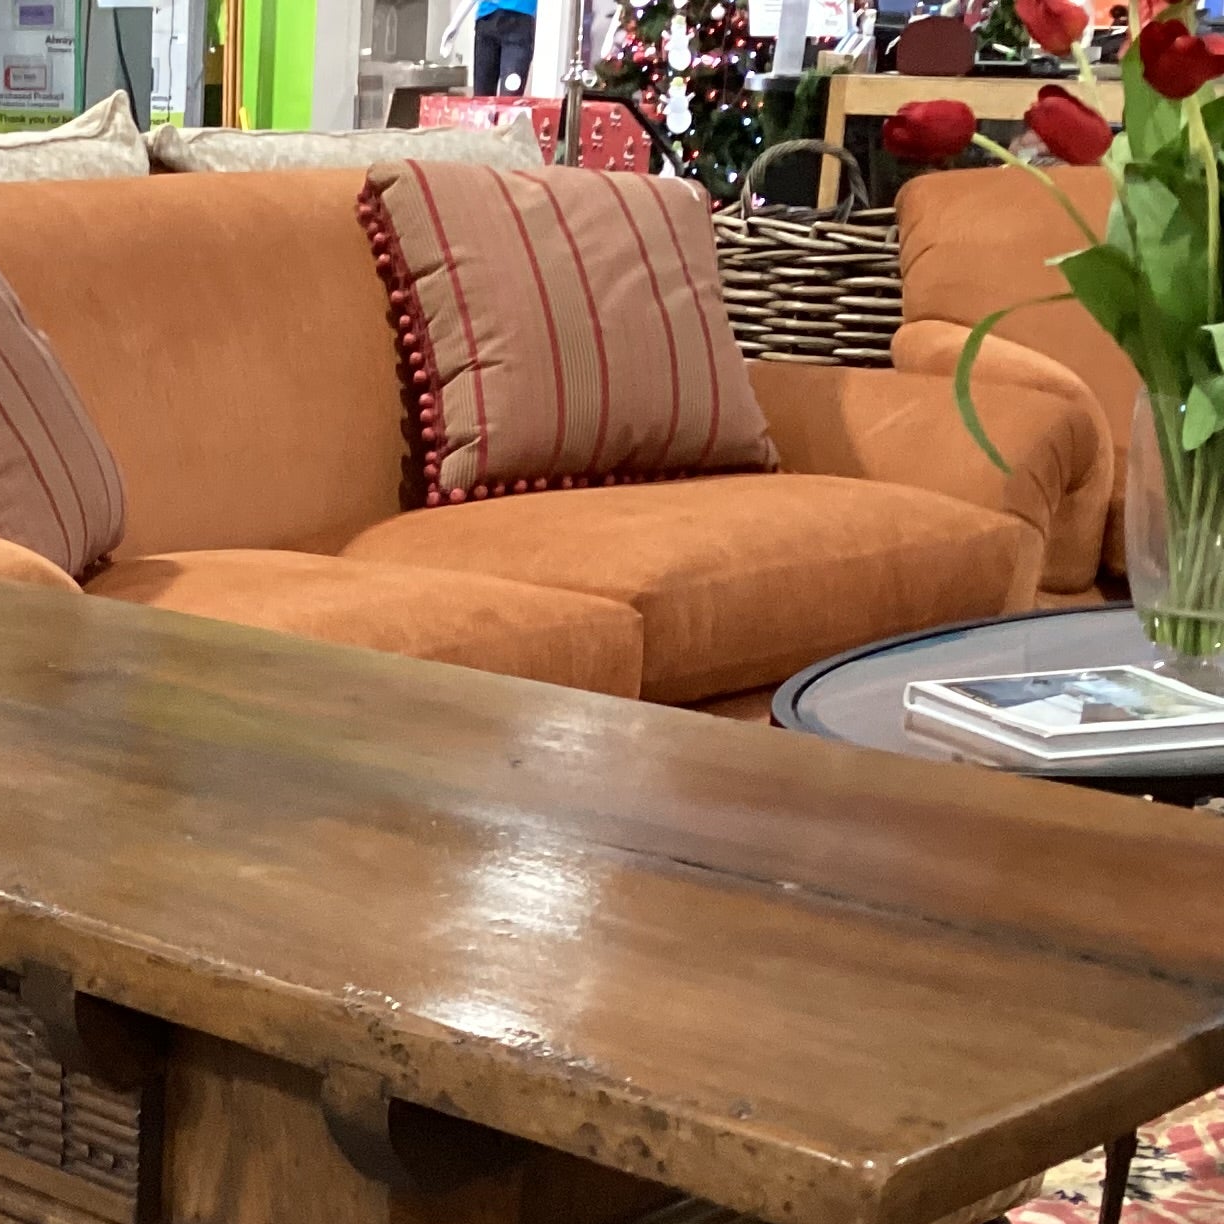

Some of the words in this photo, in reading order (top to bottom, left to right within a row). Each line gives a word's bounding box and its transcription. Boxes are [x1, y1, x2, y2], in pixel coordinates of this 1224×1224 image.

[45, 34, 74, 46] Alway
[34, 91, 64, 101] Product
[0, 113, 26, 123] Thank
[29, 116, 45, 124] you
[47, 114, 60, 123] for
